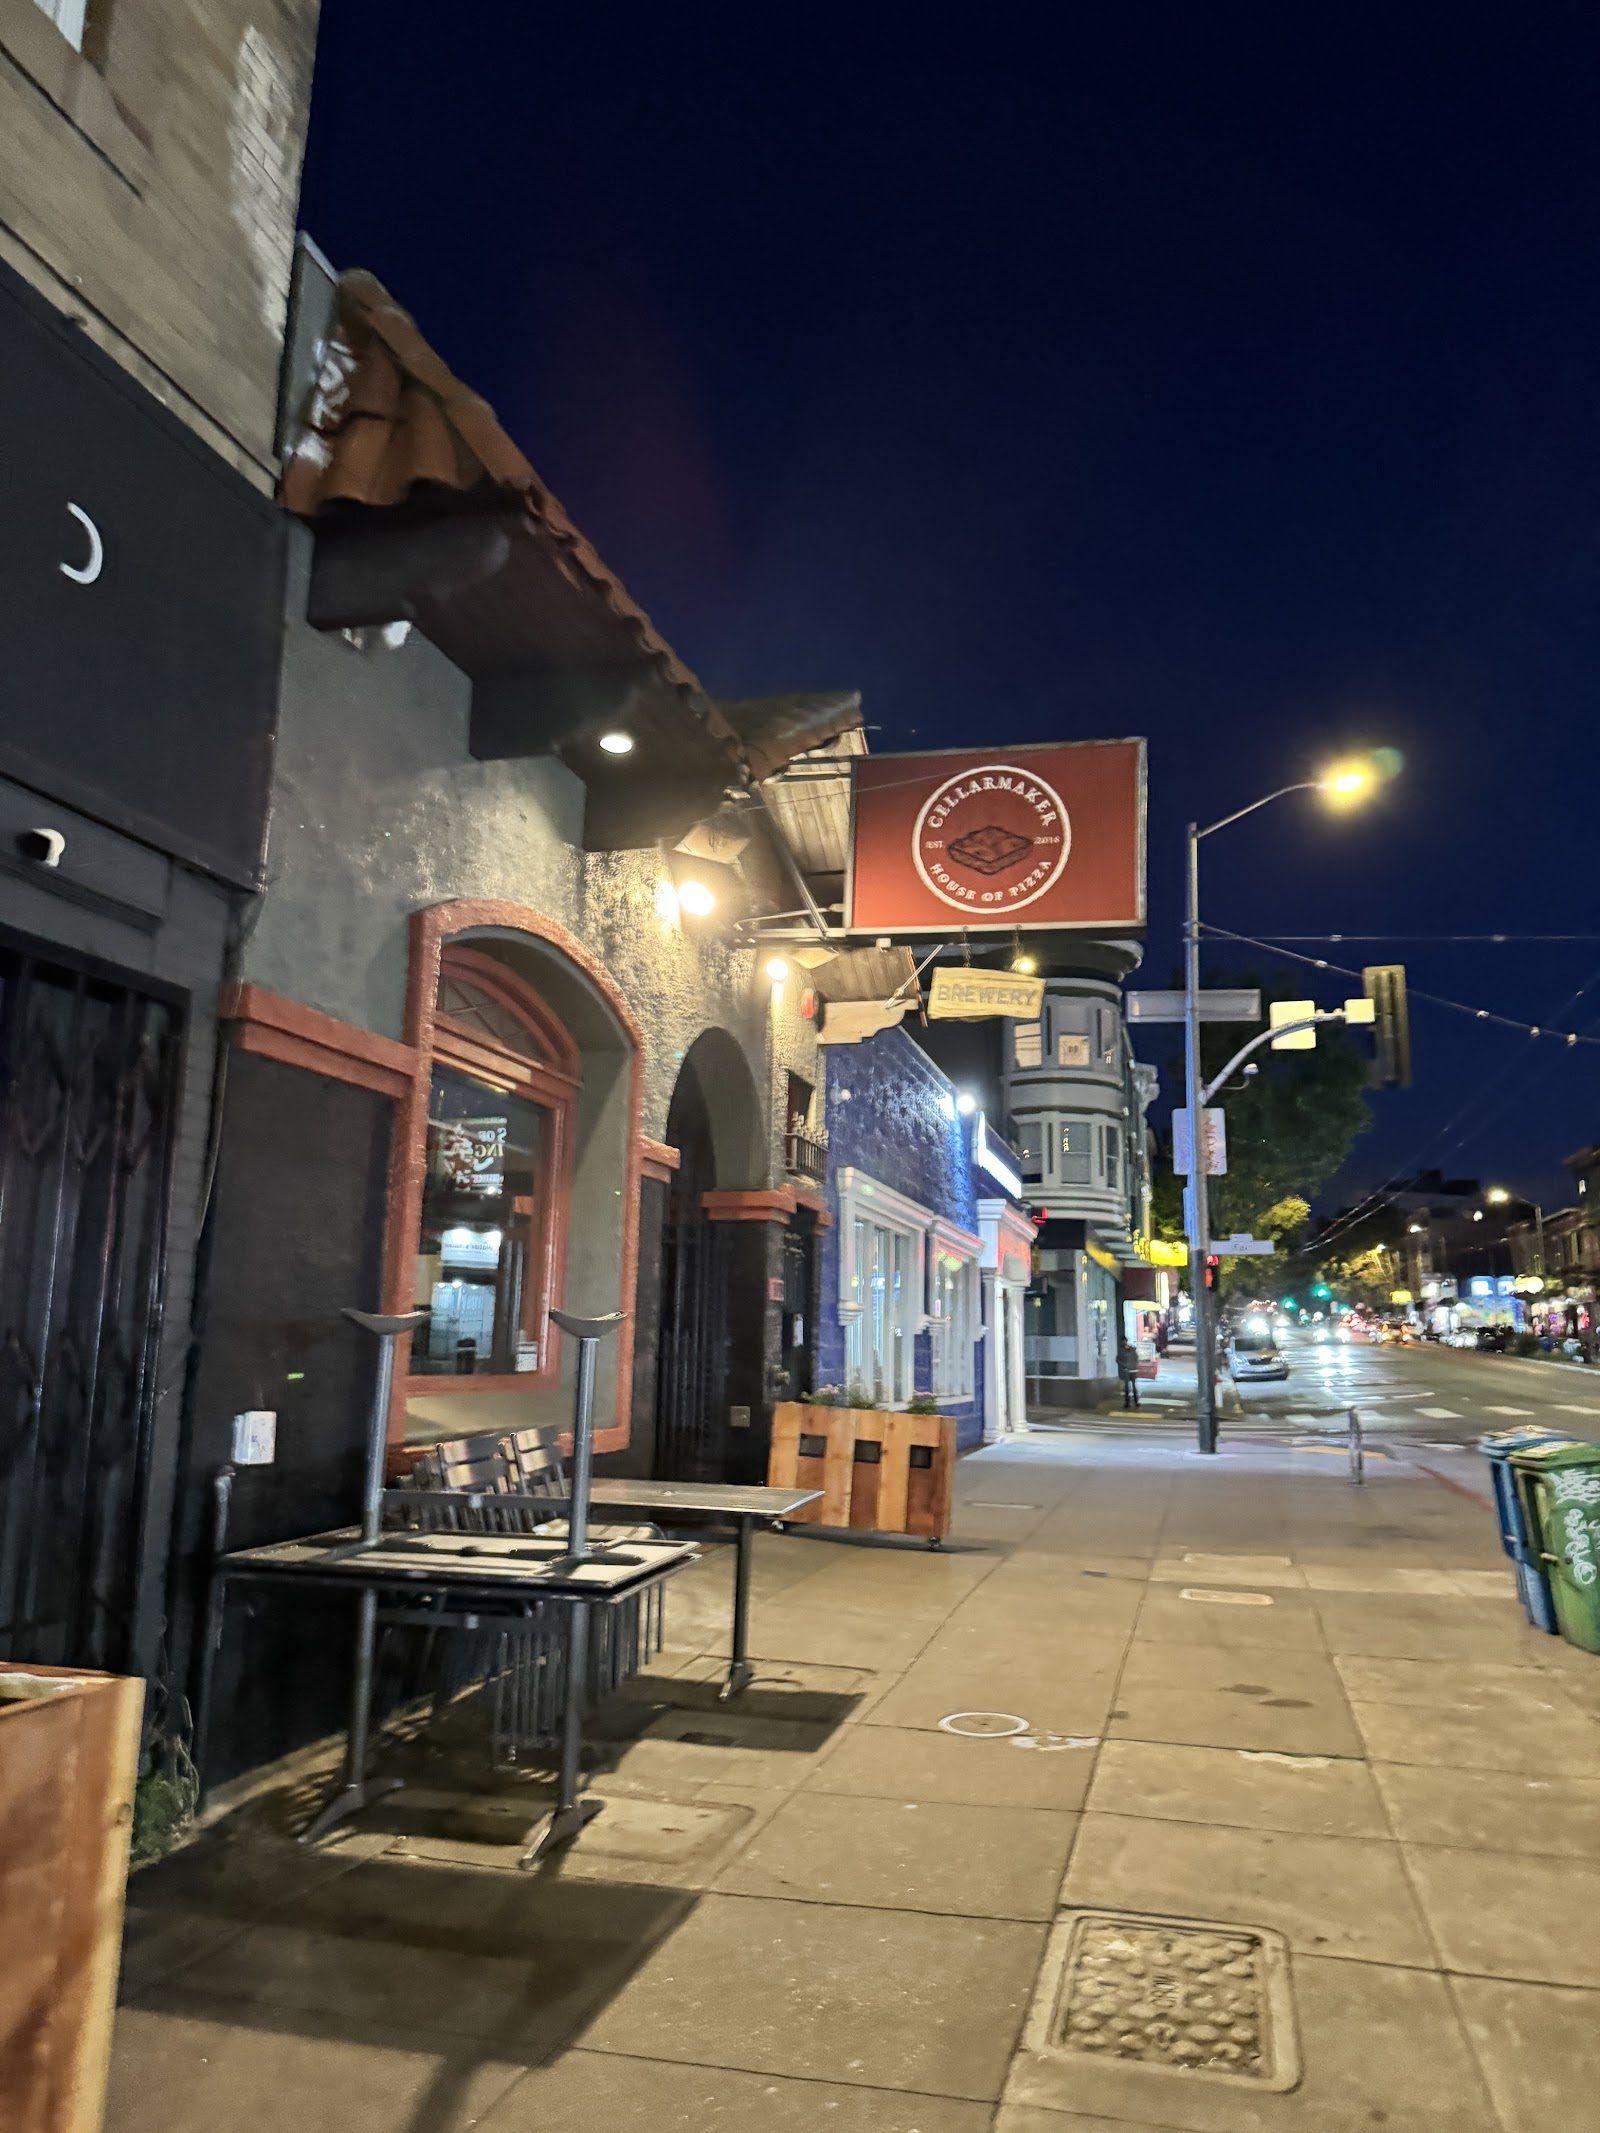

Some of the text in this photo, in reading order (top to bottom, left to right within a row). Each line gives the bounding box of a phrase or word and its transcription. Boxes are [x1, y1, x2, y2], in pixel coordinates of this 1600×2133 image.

[927, 776, 1057, 828] CELLARMAKER
[929, 861, 1052, 902] HOUSE OF PIZZA
[937, 983, 1039, 1006] BREWERY
